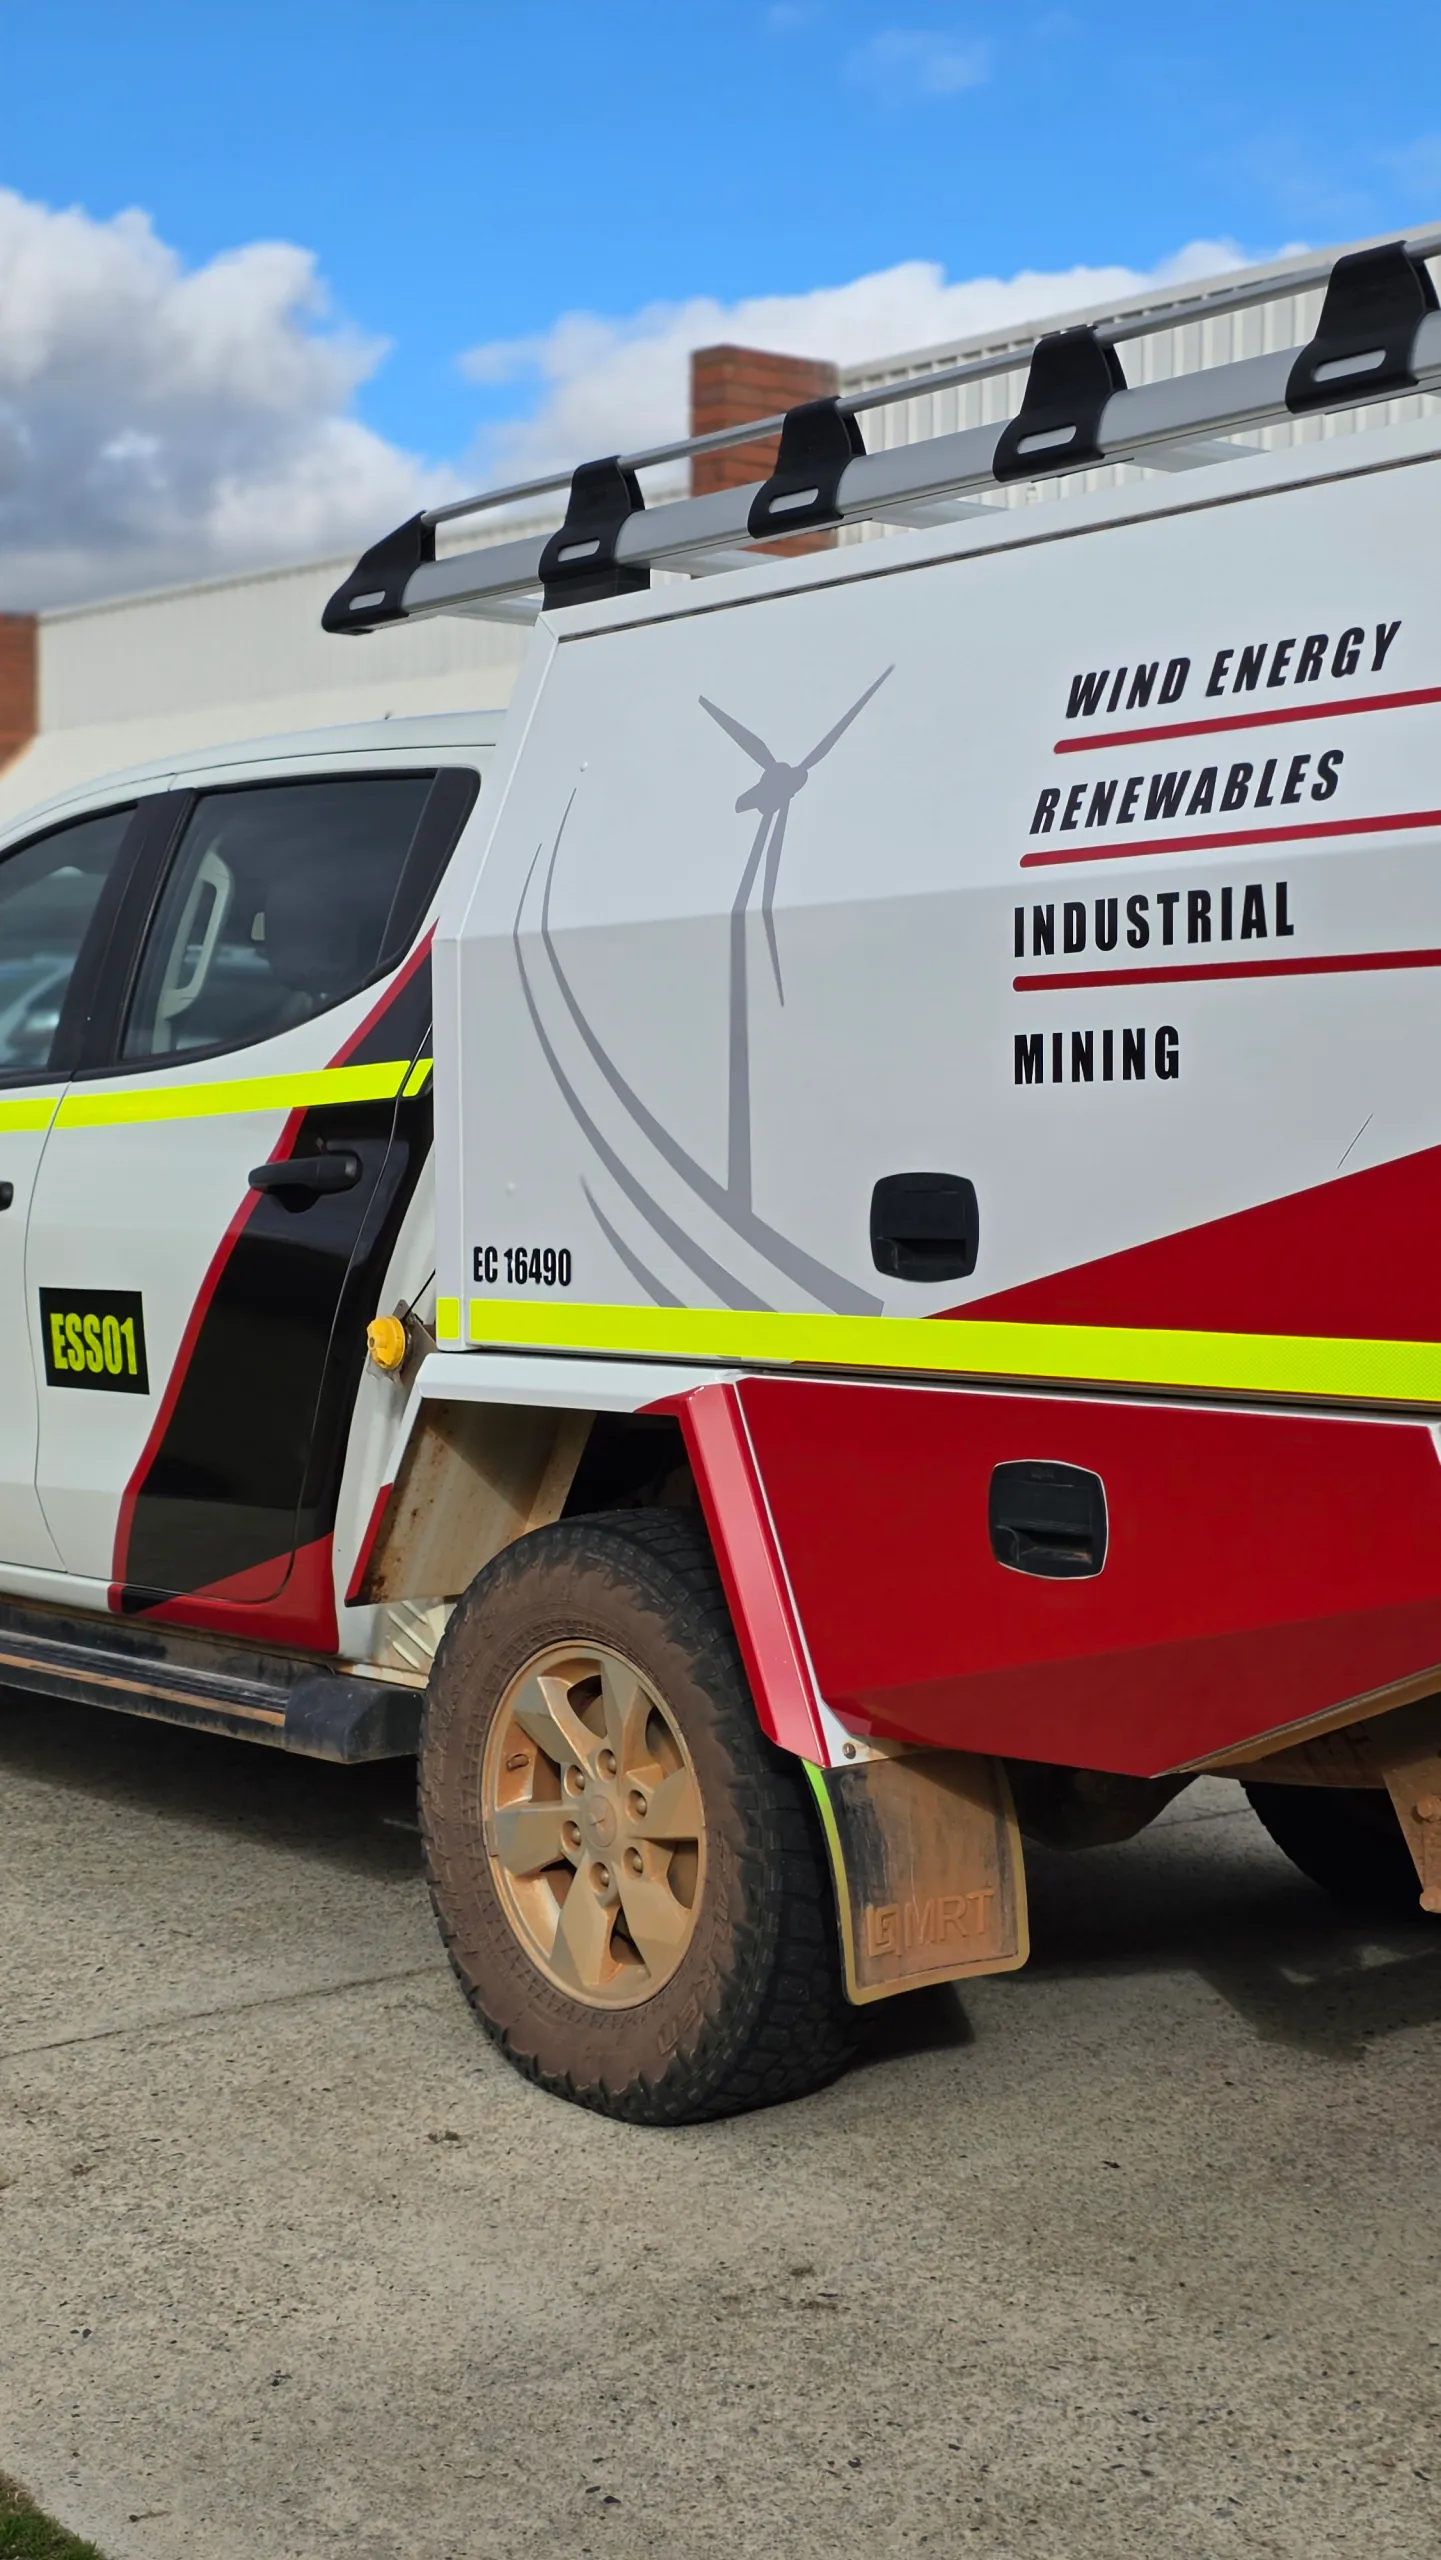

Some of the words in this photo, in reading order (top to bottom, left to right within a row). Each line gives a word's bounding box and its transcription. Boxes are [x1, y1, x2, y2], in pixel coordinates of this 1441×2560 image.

[1065, 657, 1191, 719] WIND
[1205, 620, 1402, 697] ENERGY
[1029, 749, 1345, 835] RENEWABLES
[1014, 881, 1294, 958] INDUSTRIAL
[1014, 1025, 1180, 1085] MINING
[473, 1246, 498, 1283] EC
[503, 1247, 571, 1286] 16490
[50, 1312, 138, 1375] ESS01
